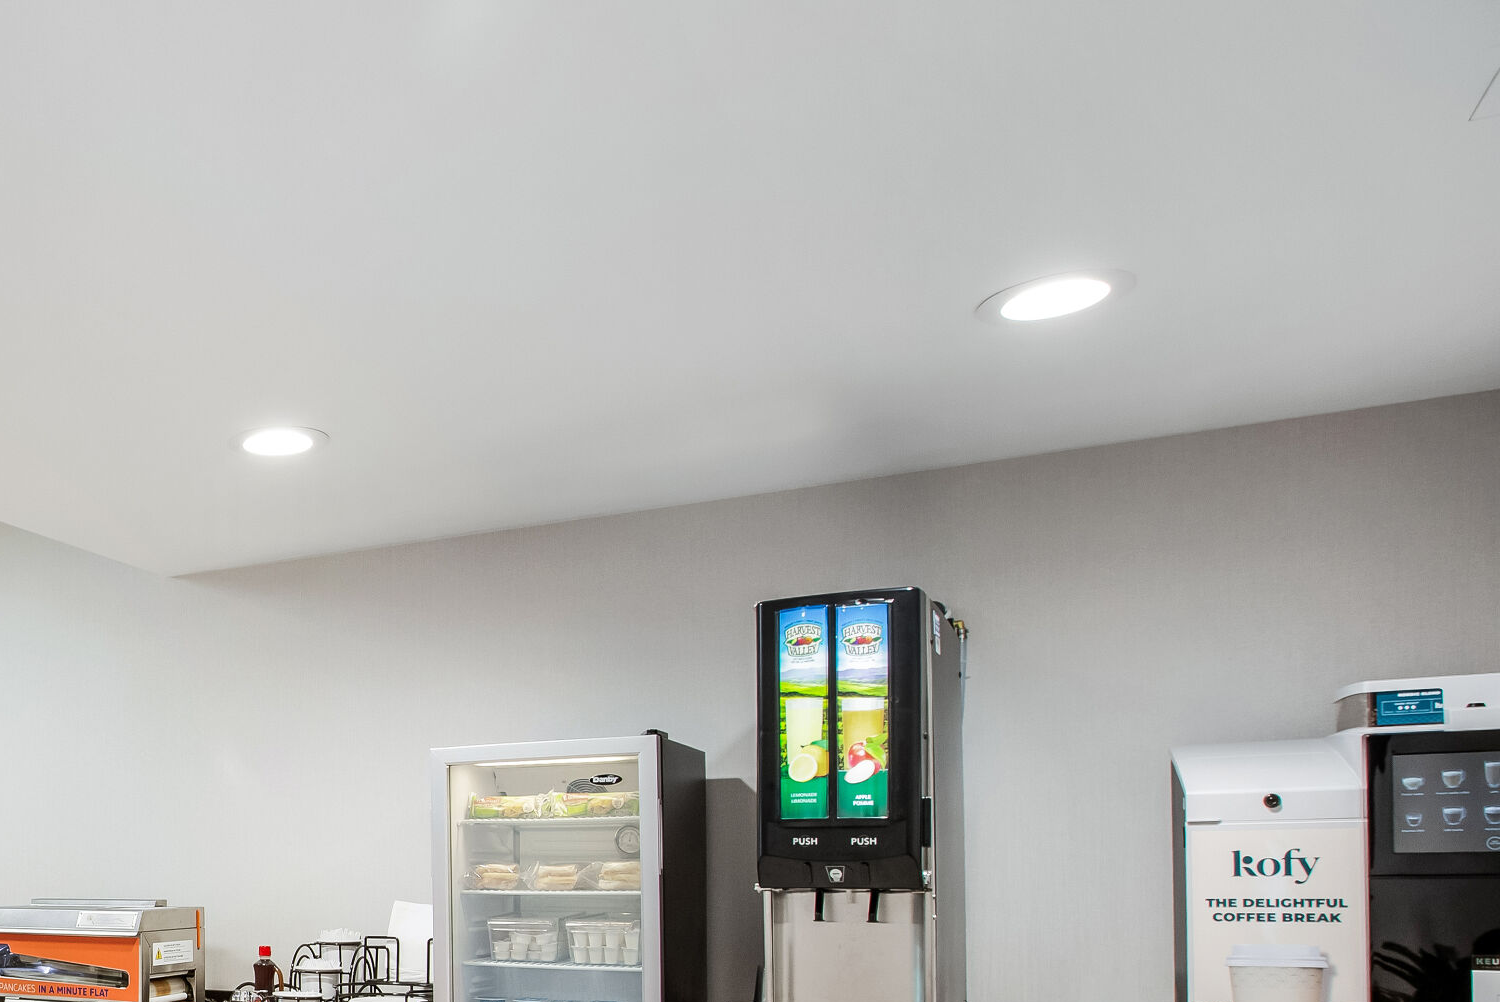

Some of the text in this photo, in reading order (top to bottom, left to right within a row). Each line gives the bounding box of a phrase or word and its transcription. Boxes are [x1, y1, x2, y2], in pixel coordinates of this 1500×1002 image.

[786, 624, 821, 638] HARVEST
[843, 624, 882, 637] HARVEST
[789, 644, 818, 656] VALLEY
[847, 644, 877, 656] VALLEY
[592, 776, 619, 784] Danby
[792, 837, 818, 846] PUSH
[850, 837, 878, 846] PUSH
[1231, 848, 1320, 885] kofy
[1205, 898, 1348, 908] THE DELIGHTFUL
[1212, 912, 1342, 923] COFFEE BREAK
[38, 985, 46, 993] IN
[49, 986, 55, 994] A
[56, 986, 87, 996] MINUTE
[89, 988, 109, 997] FLAT
